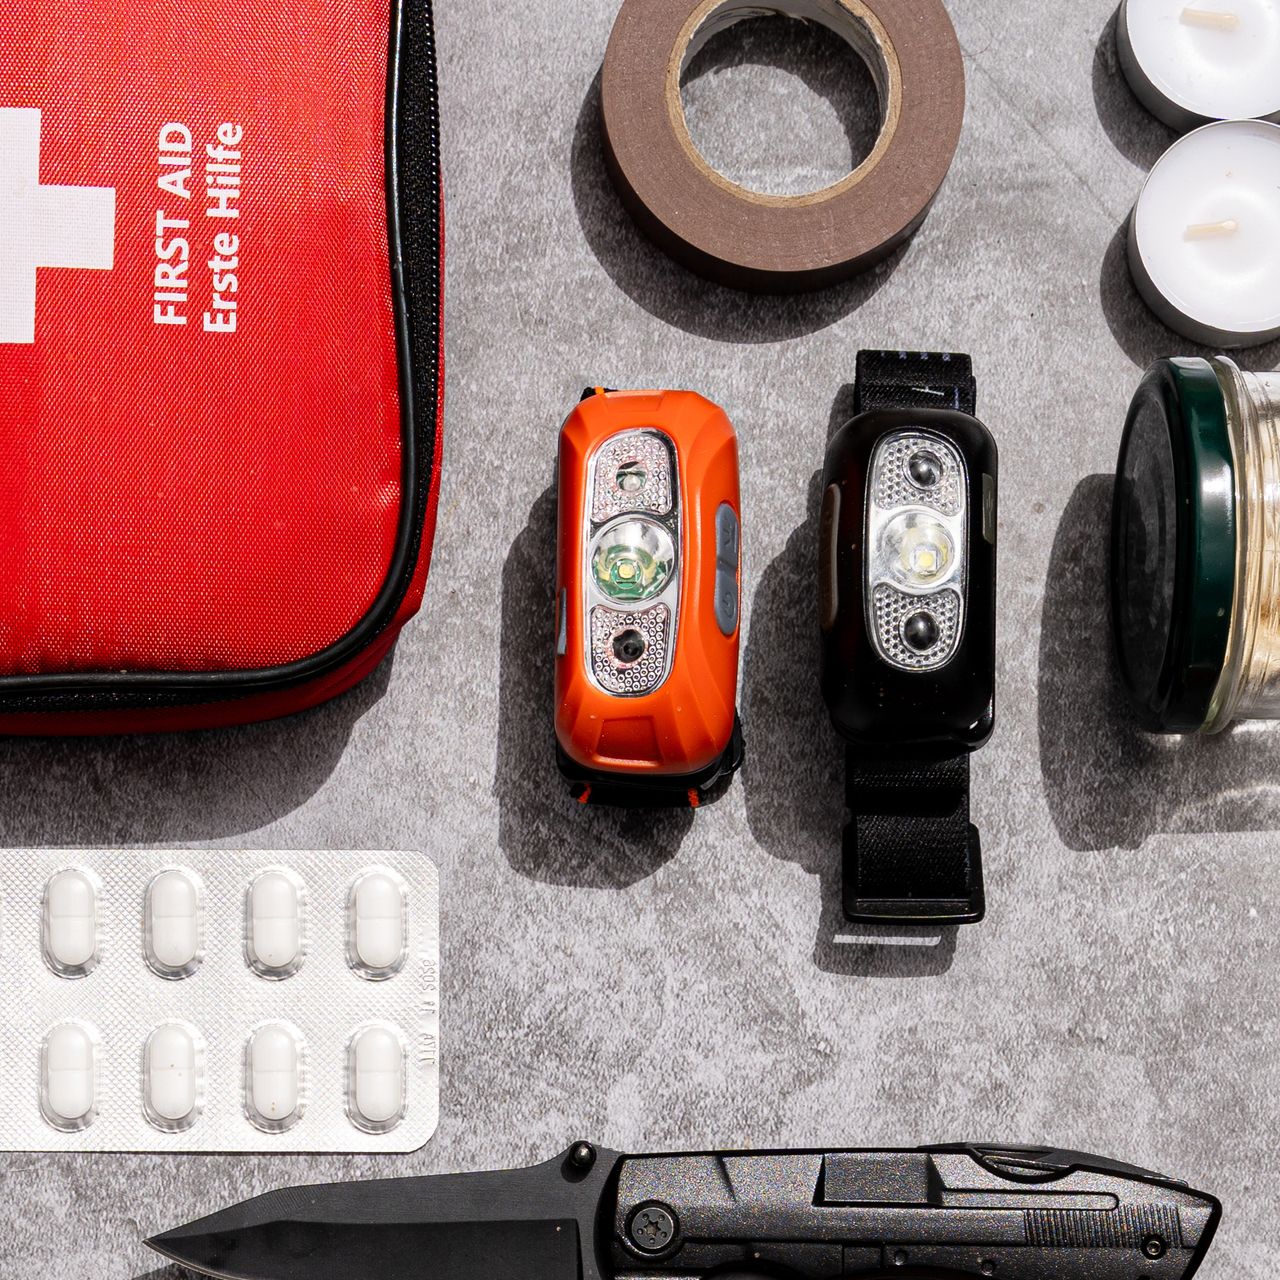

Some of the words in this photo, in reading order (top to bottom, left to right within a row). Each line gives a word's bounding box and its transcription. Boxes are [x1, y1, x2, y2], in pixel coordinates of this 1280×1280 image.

[157, 121, 193, 199] AID
[206, 121, 244, 218] Hilfe
[153, 210, 190, 325] FIRST
[203, 233, 240, 332] Erste
